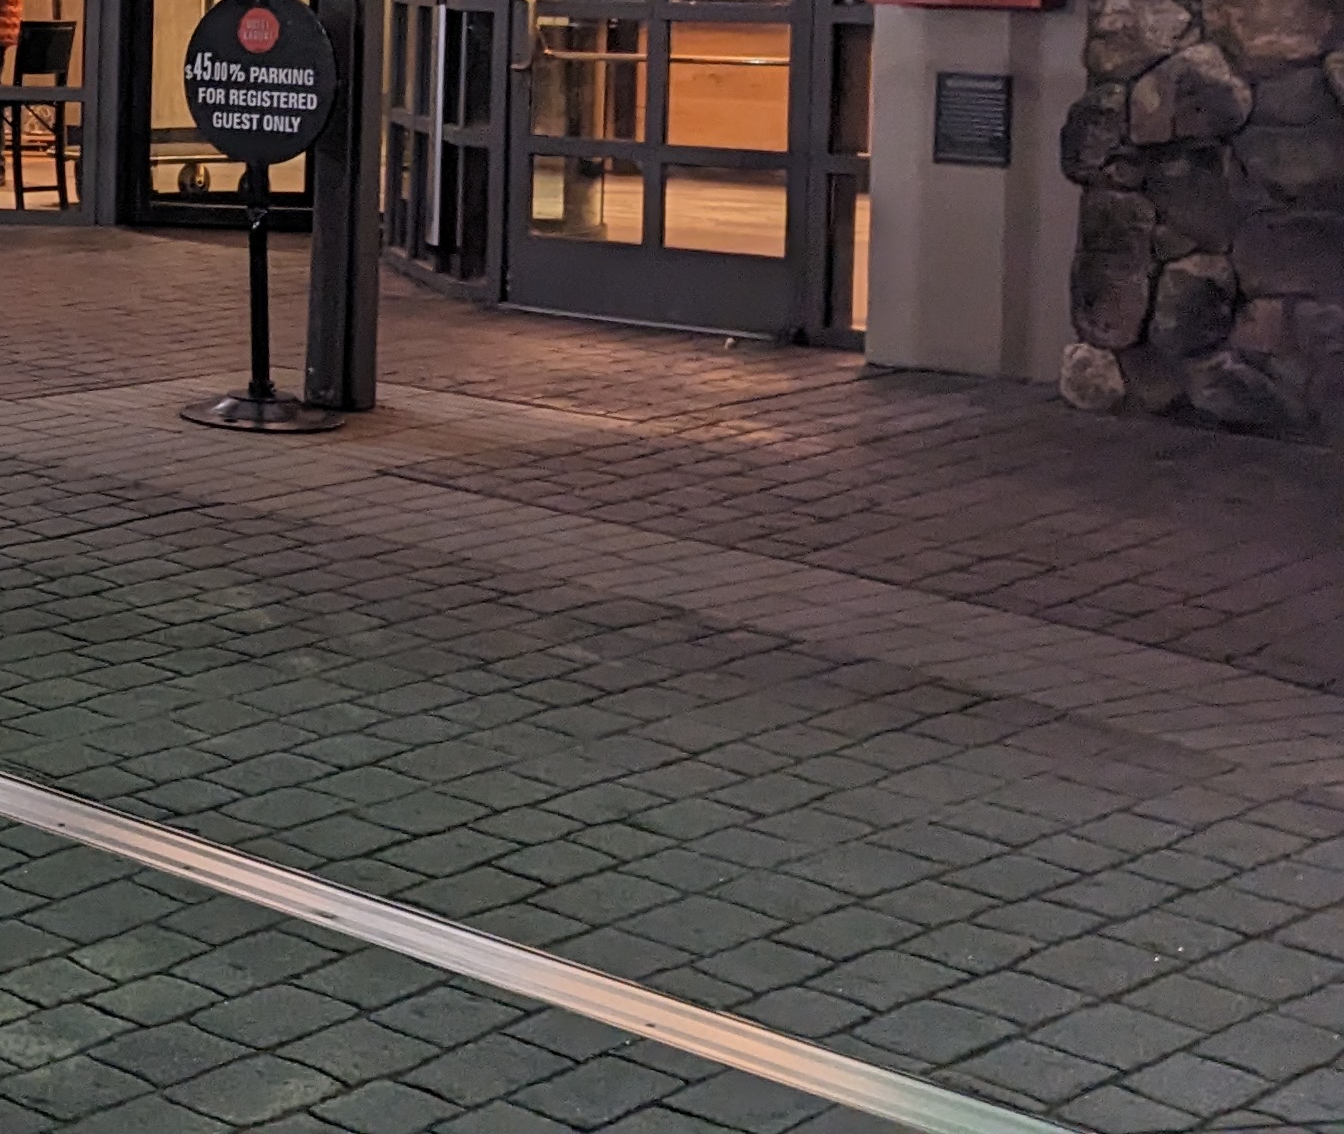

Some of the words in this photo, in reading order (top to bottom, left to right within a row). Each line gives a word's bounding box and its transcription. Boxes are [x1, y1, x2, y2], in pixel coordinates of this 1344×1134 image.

[250, 66, 314, 86] PARKING
[198, 87, 226, 104] FOR
[229, 88, 318, 110] REGISTERED
[212, 112, 260, 130] GUEST
[263, 114, 301, 133] ONLY
